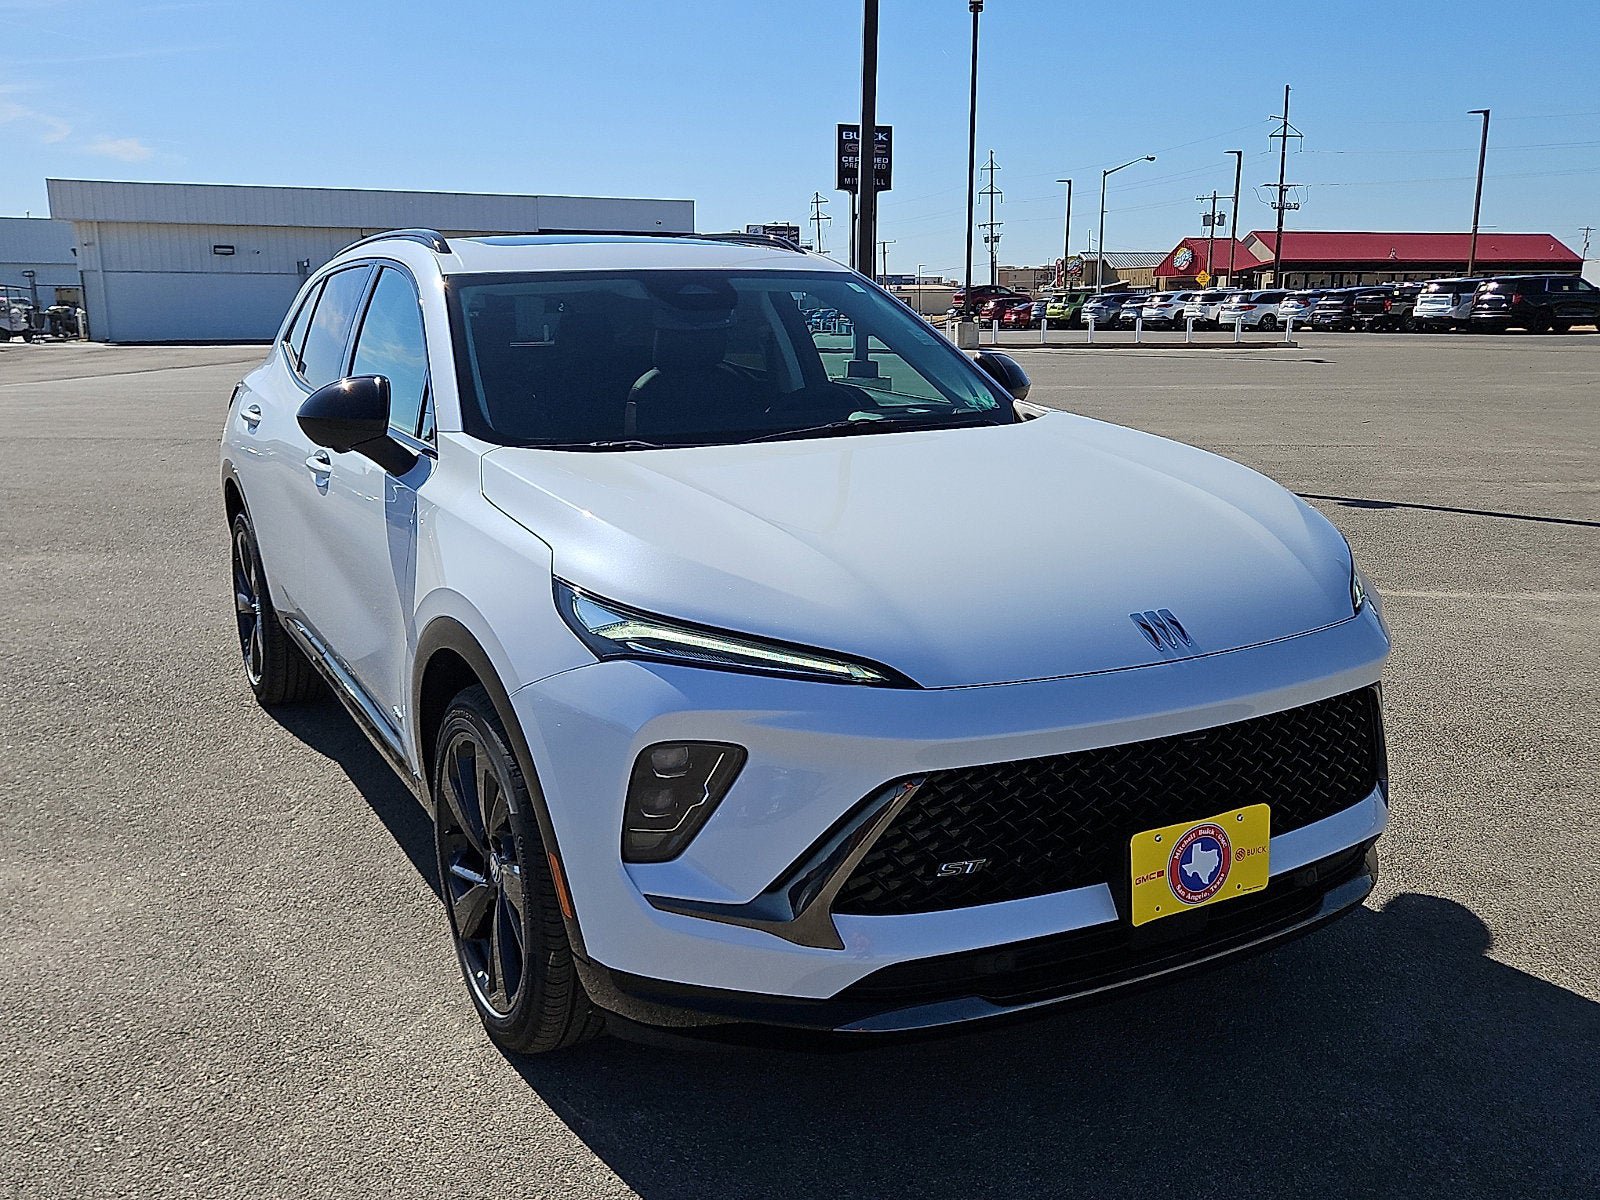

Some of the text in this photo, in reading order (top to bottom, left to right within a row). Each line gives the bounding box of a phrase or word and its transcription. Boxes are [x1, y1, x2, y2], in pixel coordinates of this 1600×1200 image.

[842, 131, 888, 141] BUK
[844, 142, 887, 153] GC
[1173, 832, 1197, 860] Mitchell
[1246, 846, 1267, 857] BUICK
[936, 858, 987, 877] ST
[1135, 872, 1158, 886] GMC
[1209, 872, 1226, 892] Texas
